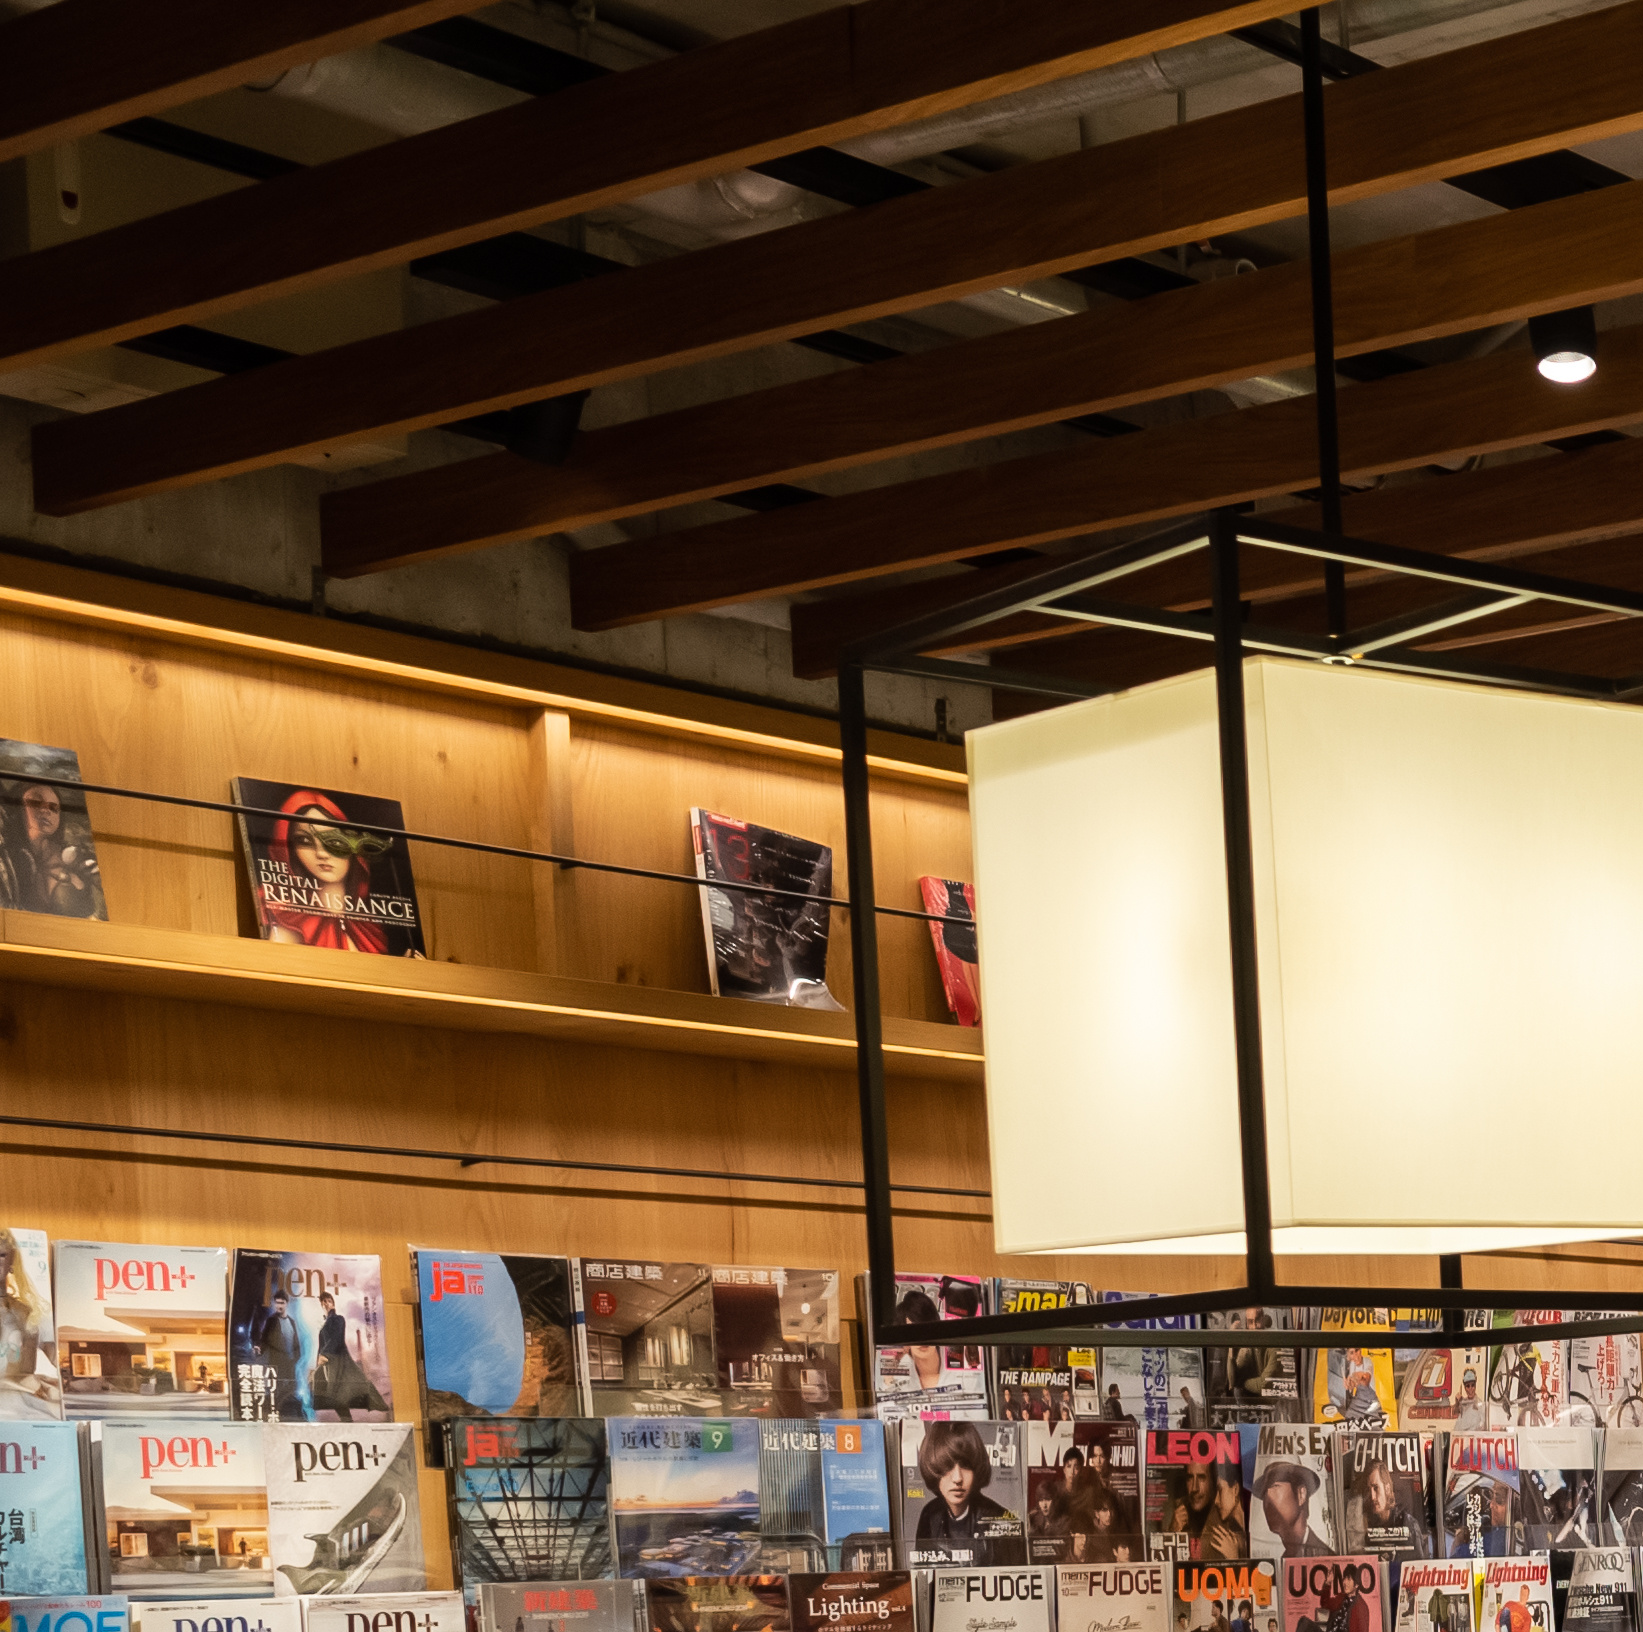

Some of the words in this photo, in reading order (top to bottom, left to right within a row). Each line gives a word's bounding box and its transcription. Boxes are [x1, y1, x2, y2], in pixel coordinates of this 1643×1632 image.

[258, 859, 288, 874] THE
[260, 871, 323, 891] DIGITAL
[262, 883, 415, 920] RENAISSANCE
[1000, 1371, 1018, 1386] THE
[1020, 1370, 1071, 1387] RAMPAGE
[711, 1430, 723, 1450] 9
[843, 1431, 855, 1451] 8
[1147, 1432, 1241, 1464] LEON
[1450, 1437, 1518, 1472] CLUTCH
[966, 1573, 1043, 1602] FUDGE
[1088, 1569, 1163, 1597] FUDGE
[1401, 1565, 1471, 1592] Lightning
[1484, 1562, 1549, 1589] Lightning
[808, 1595, 890, 1621] Lighting
